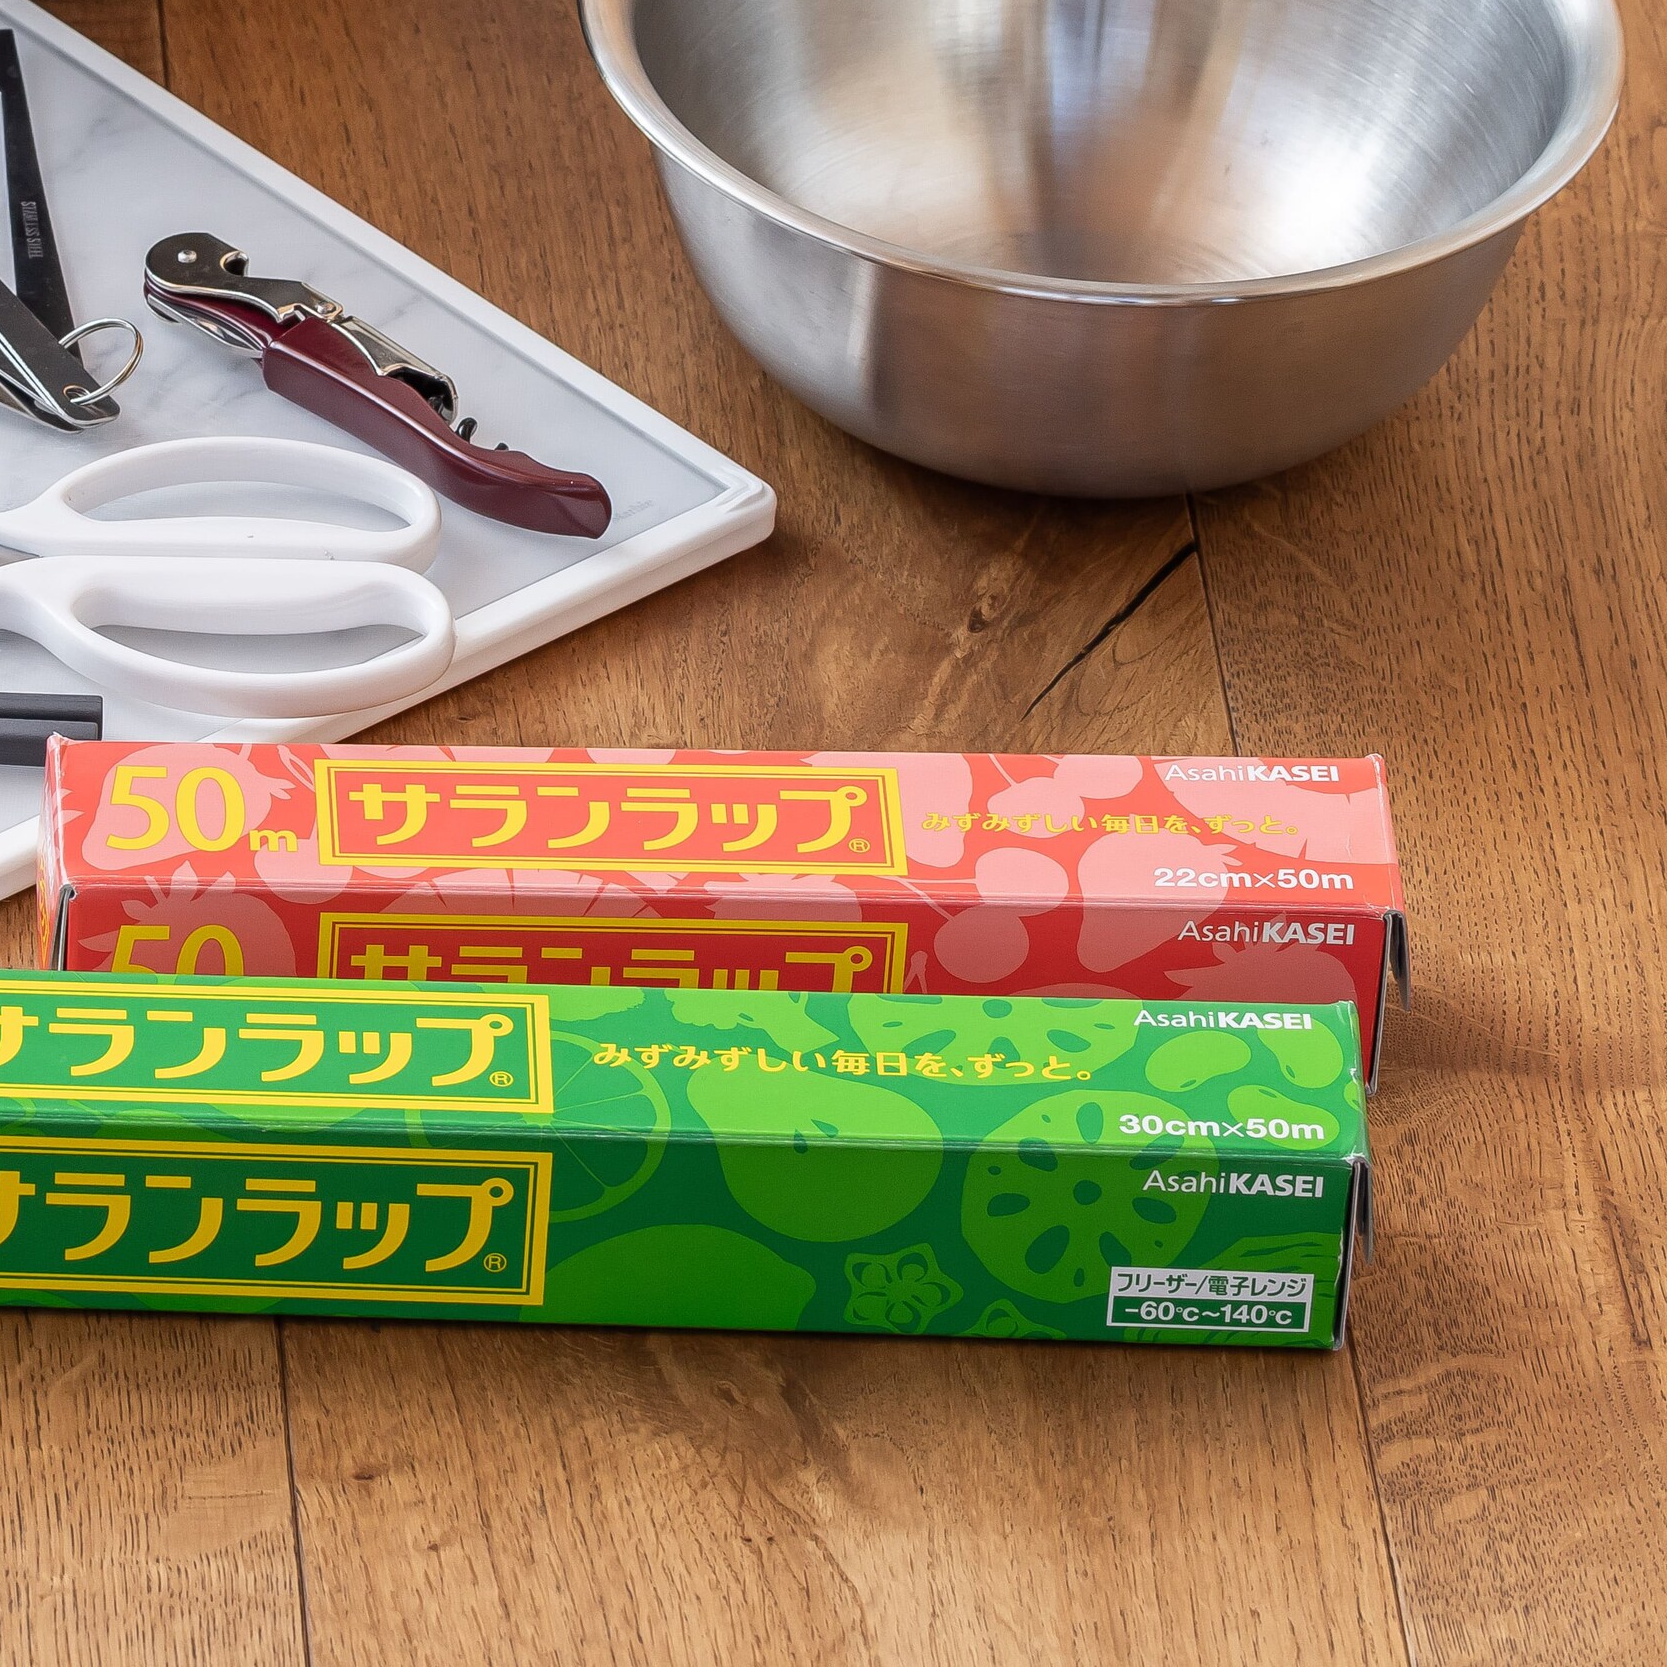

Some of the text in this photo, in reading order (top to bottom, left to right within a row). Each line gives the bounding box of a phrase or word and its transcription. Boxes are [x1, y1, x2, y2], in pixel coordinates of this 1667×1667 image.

[922, 811, 1301, 837] みずみずしい毎日を、ずっと。
[594, 1043, 1094, 1081] みずみずしい毎日を、ずっと。
